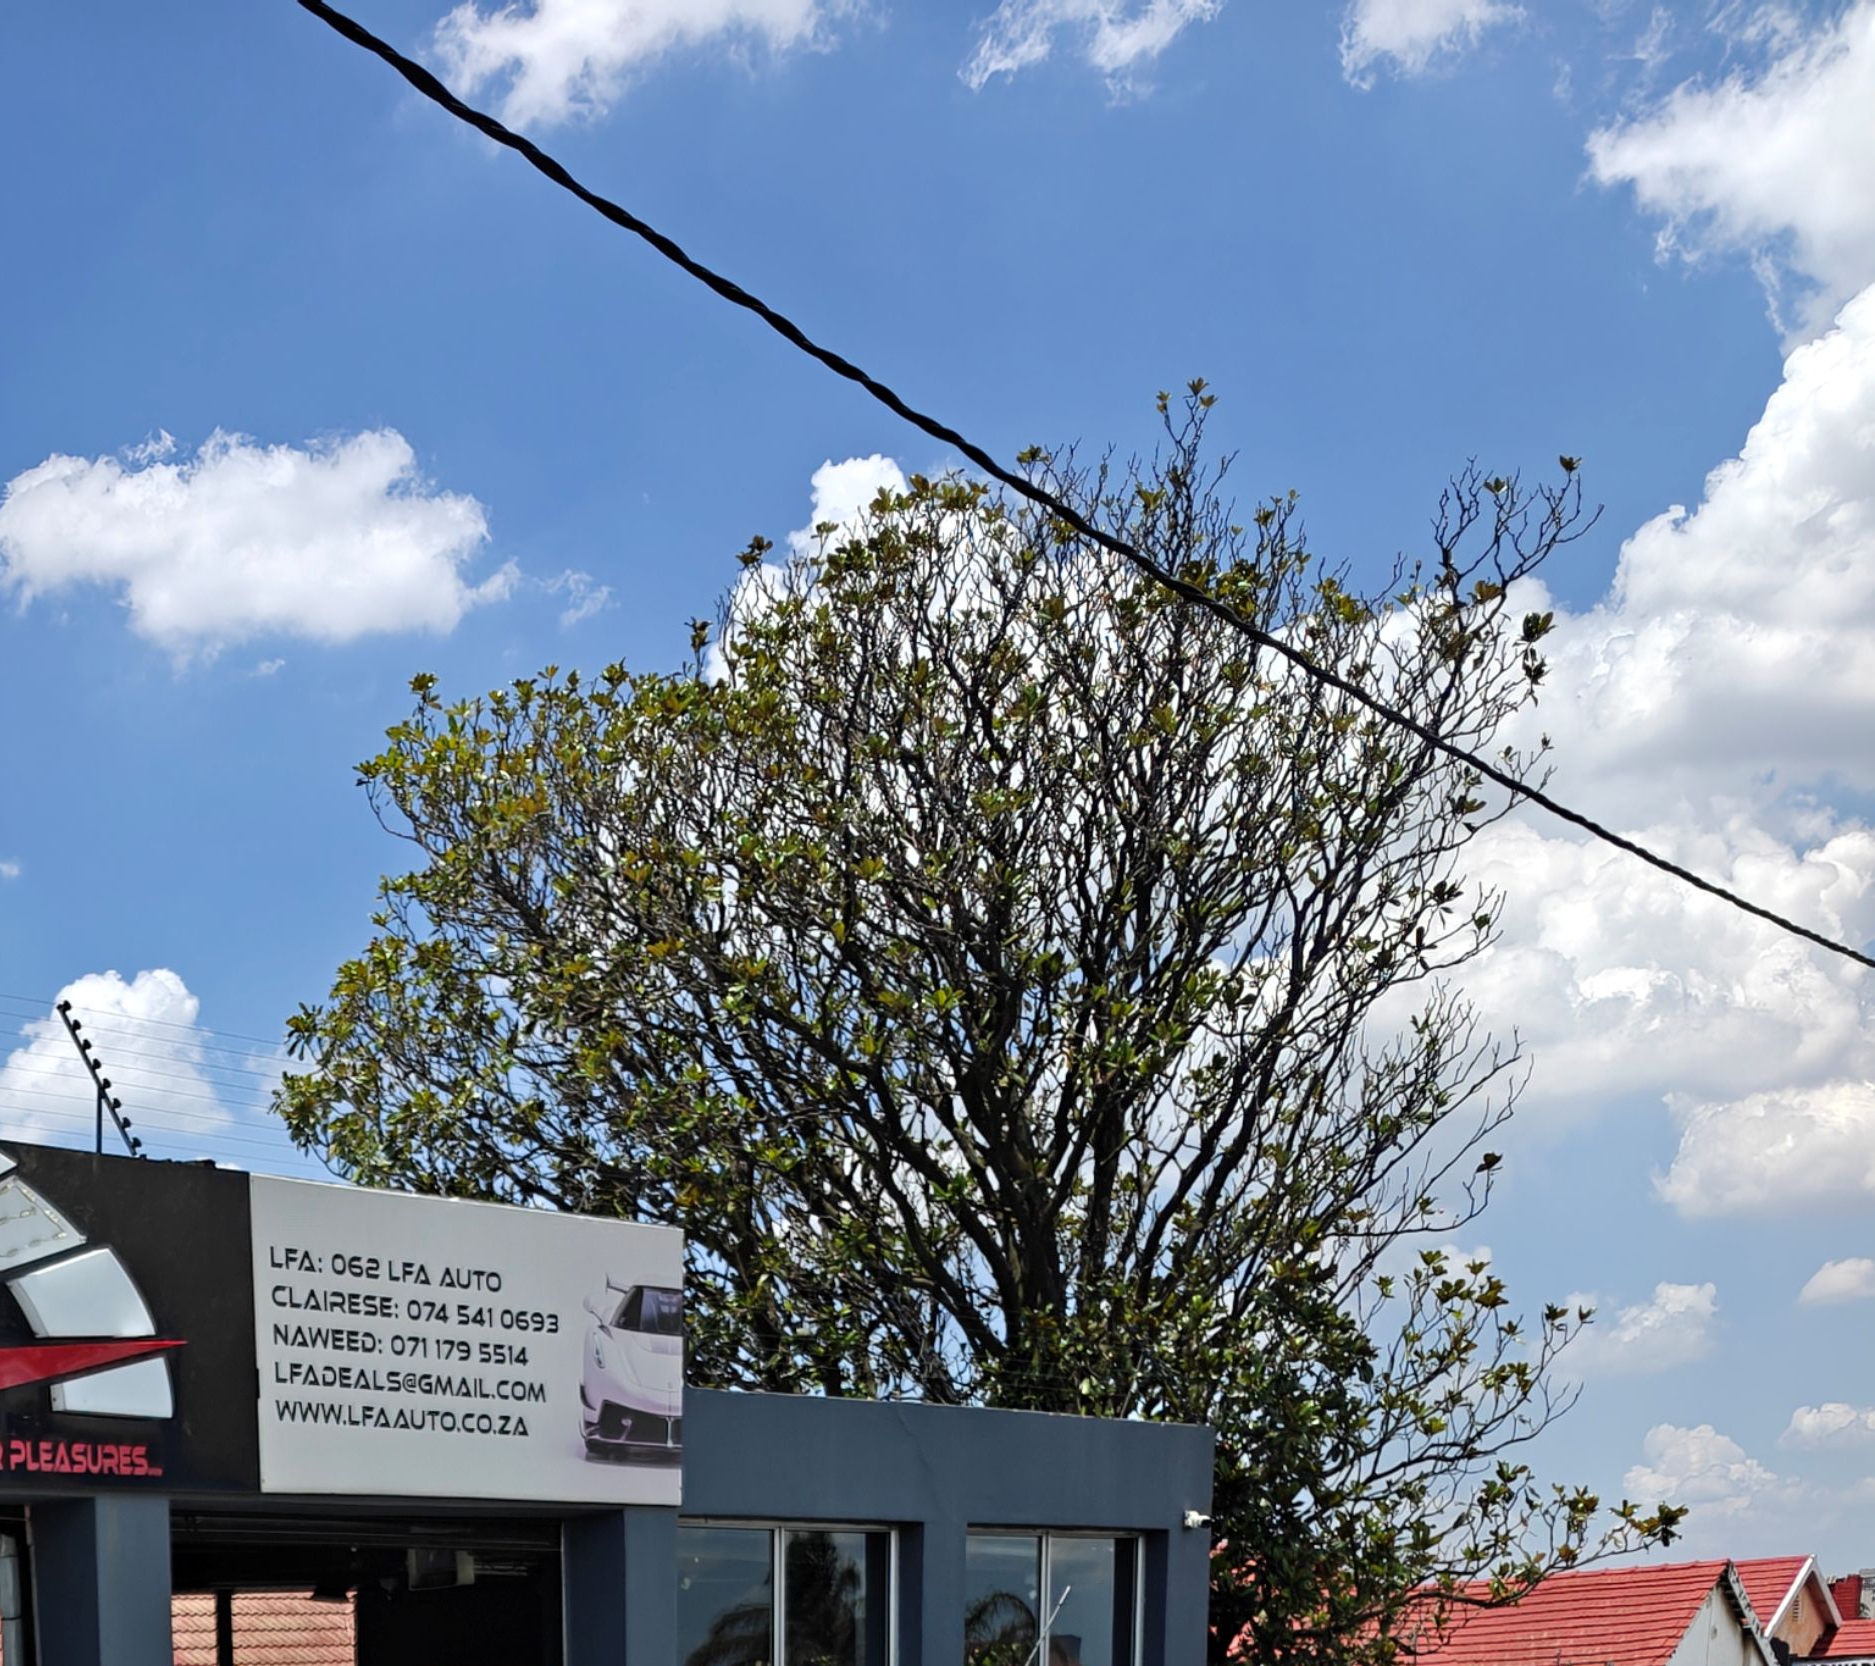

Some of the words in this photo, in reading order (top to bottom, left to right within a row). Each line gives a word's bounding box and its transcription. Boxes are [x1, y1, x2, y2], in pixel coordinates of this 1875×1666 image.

[270, 1246, 322, 1273] LFA:
[332, 1254, 379, 1279] 062
[389, 1261, 431, 1285] LFA
[440, 1268, 501, 1292] AUTO
[272, 1285, 398, 1318] CLAIRESE:
[407, 1300, 449, 1323] 074
[457, 1305, 492, 1327] 541
[501, 1309, 558, 1333] 0693
[274, 1324, 382, 1354] NAWEED:
[391, 1335, 426, 1358] 071
[436, 1339, 470, 1361] 179
[479, 1343, 528, 1366] 5514
[275, 1362, 546, 1402] LFADEALS@GMAIL.COM
[276, 1400, 528, 1436] WWW.LFAAUTO.CO.ZA
[10, 1440, 162, 1475] PLEASURES...
